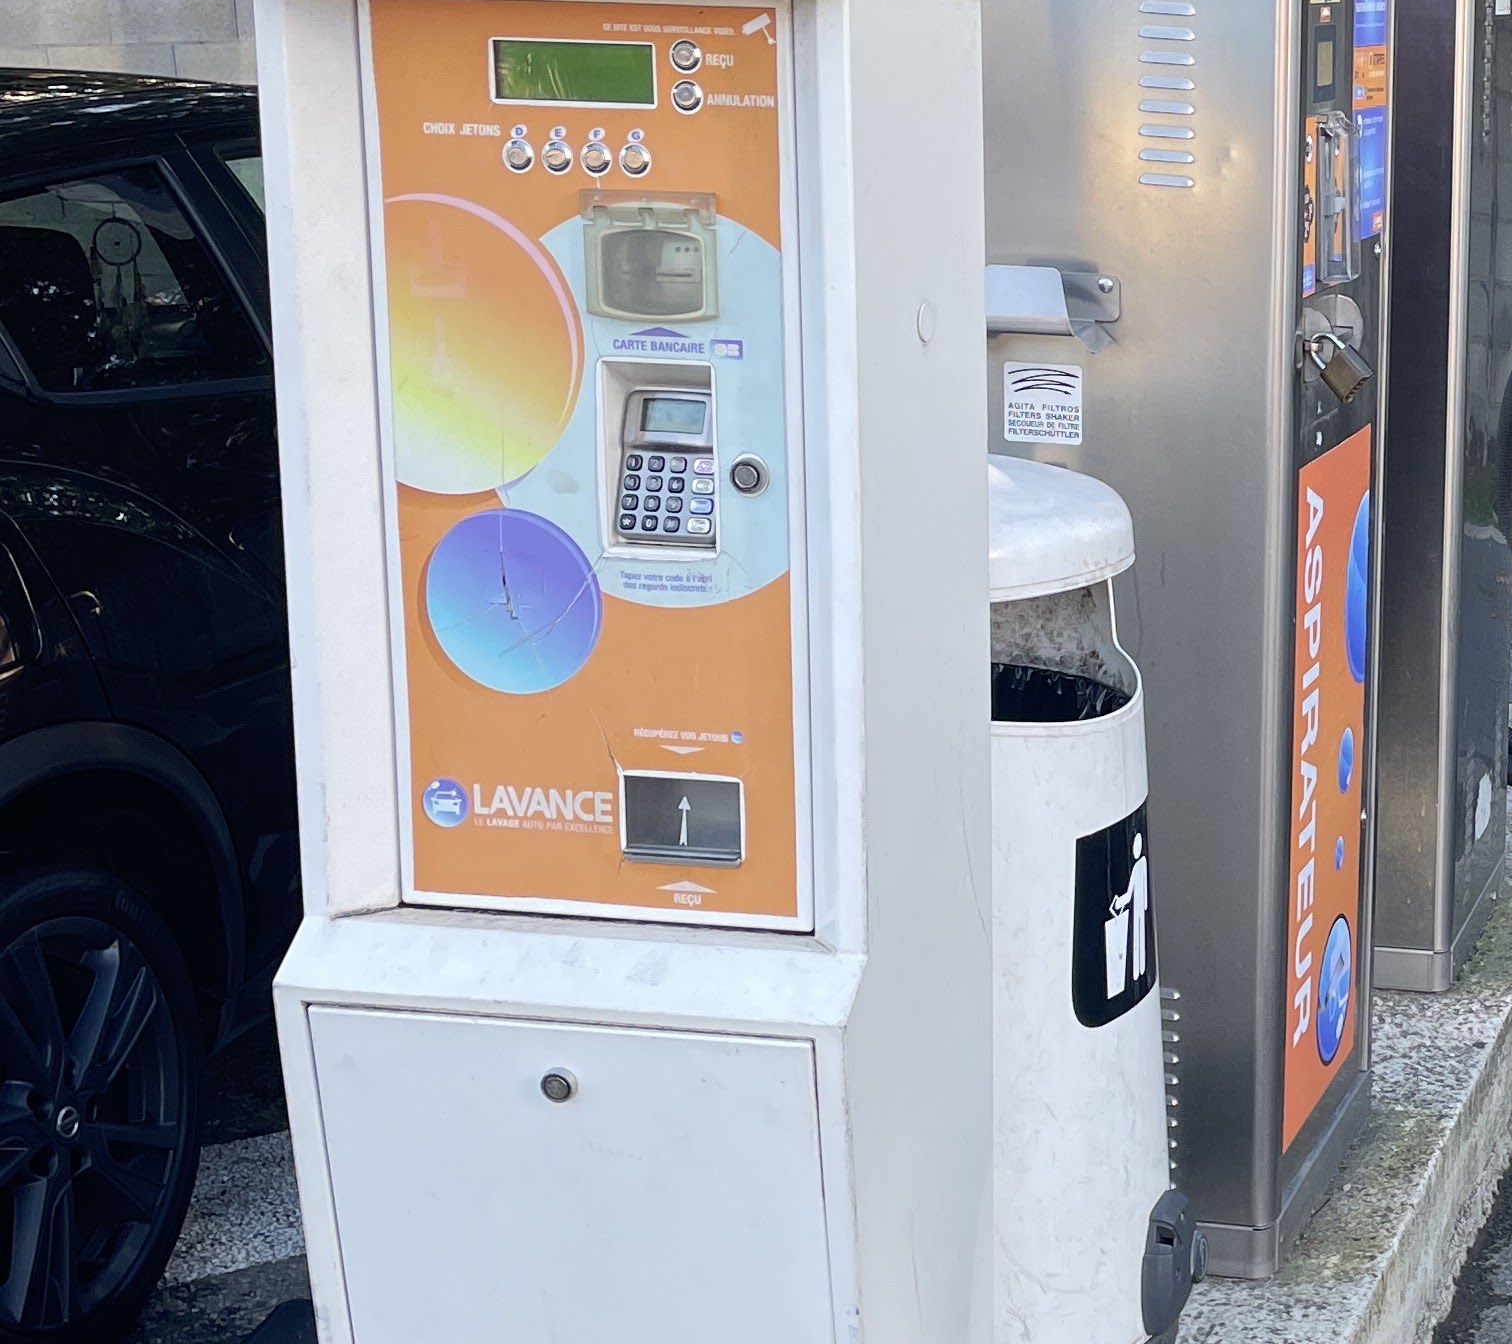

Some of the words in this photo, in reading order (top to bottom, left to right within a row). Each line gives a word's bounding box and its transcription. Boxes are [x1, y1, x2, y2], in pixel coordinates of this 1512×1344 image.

[705, 53, 734, 70] REÇU
[707, 94, 775, 107] ANNULATION
[423, 122, 455, 135] CHOIX
[459, 123, 501, 136] JETONS
[515, 127, 523, 136] D
[554, 128, 562, 138] E
[593, 129, 601, 139] F
[631, 131, 641, 141] G
[613, 339, 648, 351] CARTE
[650, 341, 705, 354] BANCAIRE
[1008, 402, 1035, 410] AGITA
[1042, 403, 1080, 413] FILTROS
[1008, 411, 1041, 419] FILTERS
[1045, 412, 1080, 421] SHAKER
[1292, 486, 1324, 1049] ASPIRATEUR
[473, 783, 614, 823] LAVANCE
[474, 817, 485, 826] LE
[486, 817, 520, 828] LAVAGE
[522, 820, 544, 830] AUTO
[546, 821, 563, 830] PAR
[564, 823, 614, 835] EXCELLENCE
[673, 892, 701, 907] REÇU
